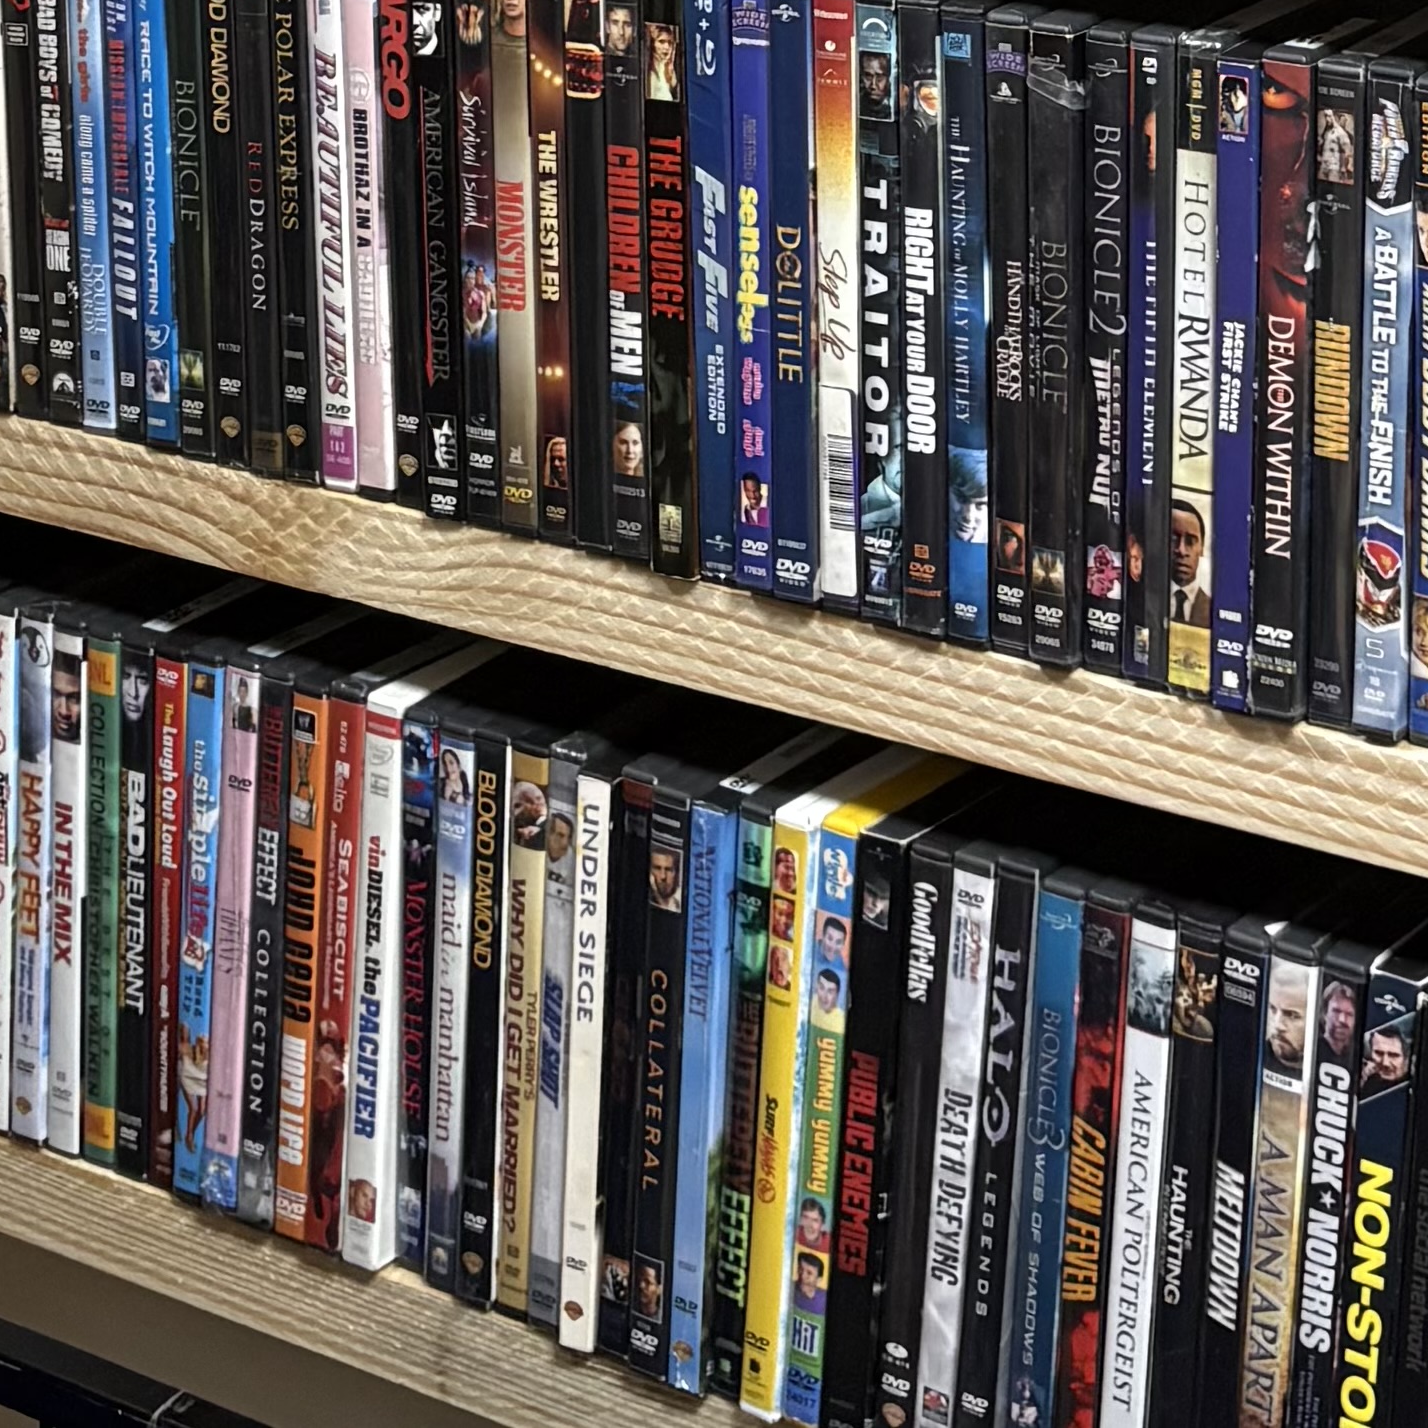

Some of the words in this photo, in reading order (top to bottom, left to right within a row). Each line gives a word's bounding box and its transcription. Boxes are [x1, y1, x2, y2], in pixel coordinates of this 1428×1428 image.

[210, 27, 231, 134] DIAMOND
[864, 179, 890, 457] TRAITOR
[577, 803, 600, 916] UNDER
[577, 930, 596, 1023] SIEGE
[643, 969, 667, 1189] COLLATERAL
[1121, 1069, 1158, 1219] AMERICAN
[1310, 1062, 1350, 1186] CHUCK
[1111, 1228, 1146, 1413] POLTERGEIST
[1208, 1161, 1245, 1330] MELTDOWN
[1297, 1210, 1340, 1353] NORRIS
[1338, 1158, 1394, 1428] NON-STO
